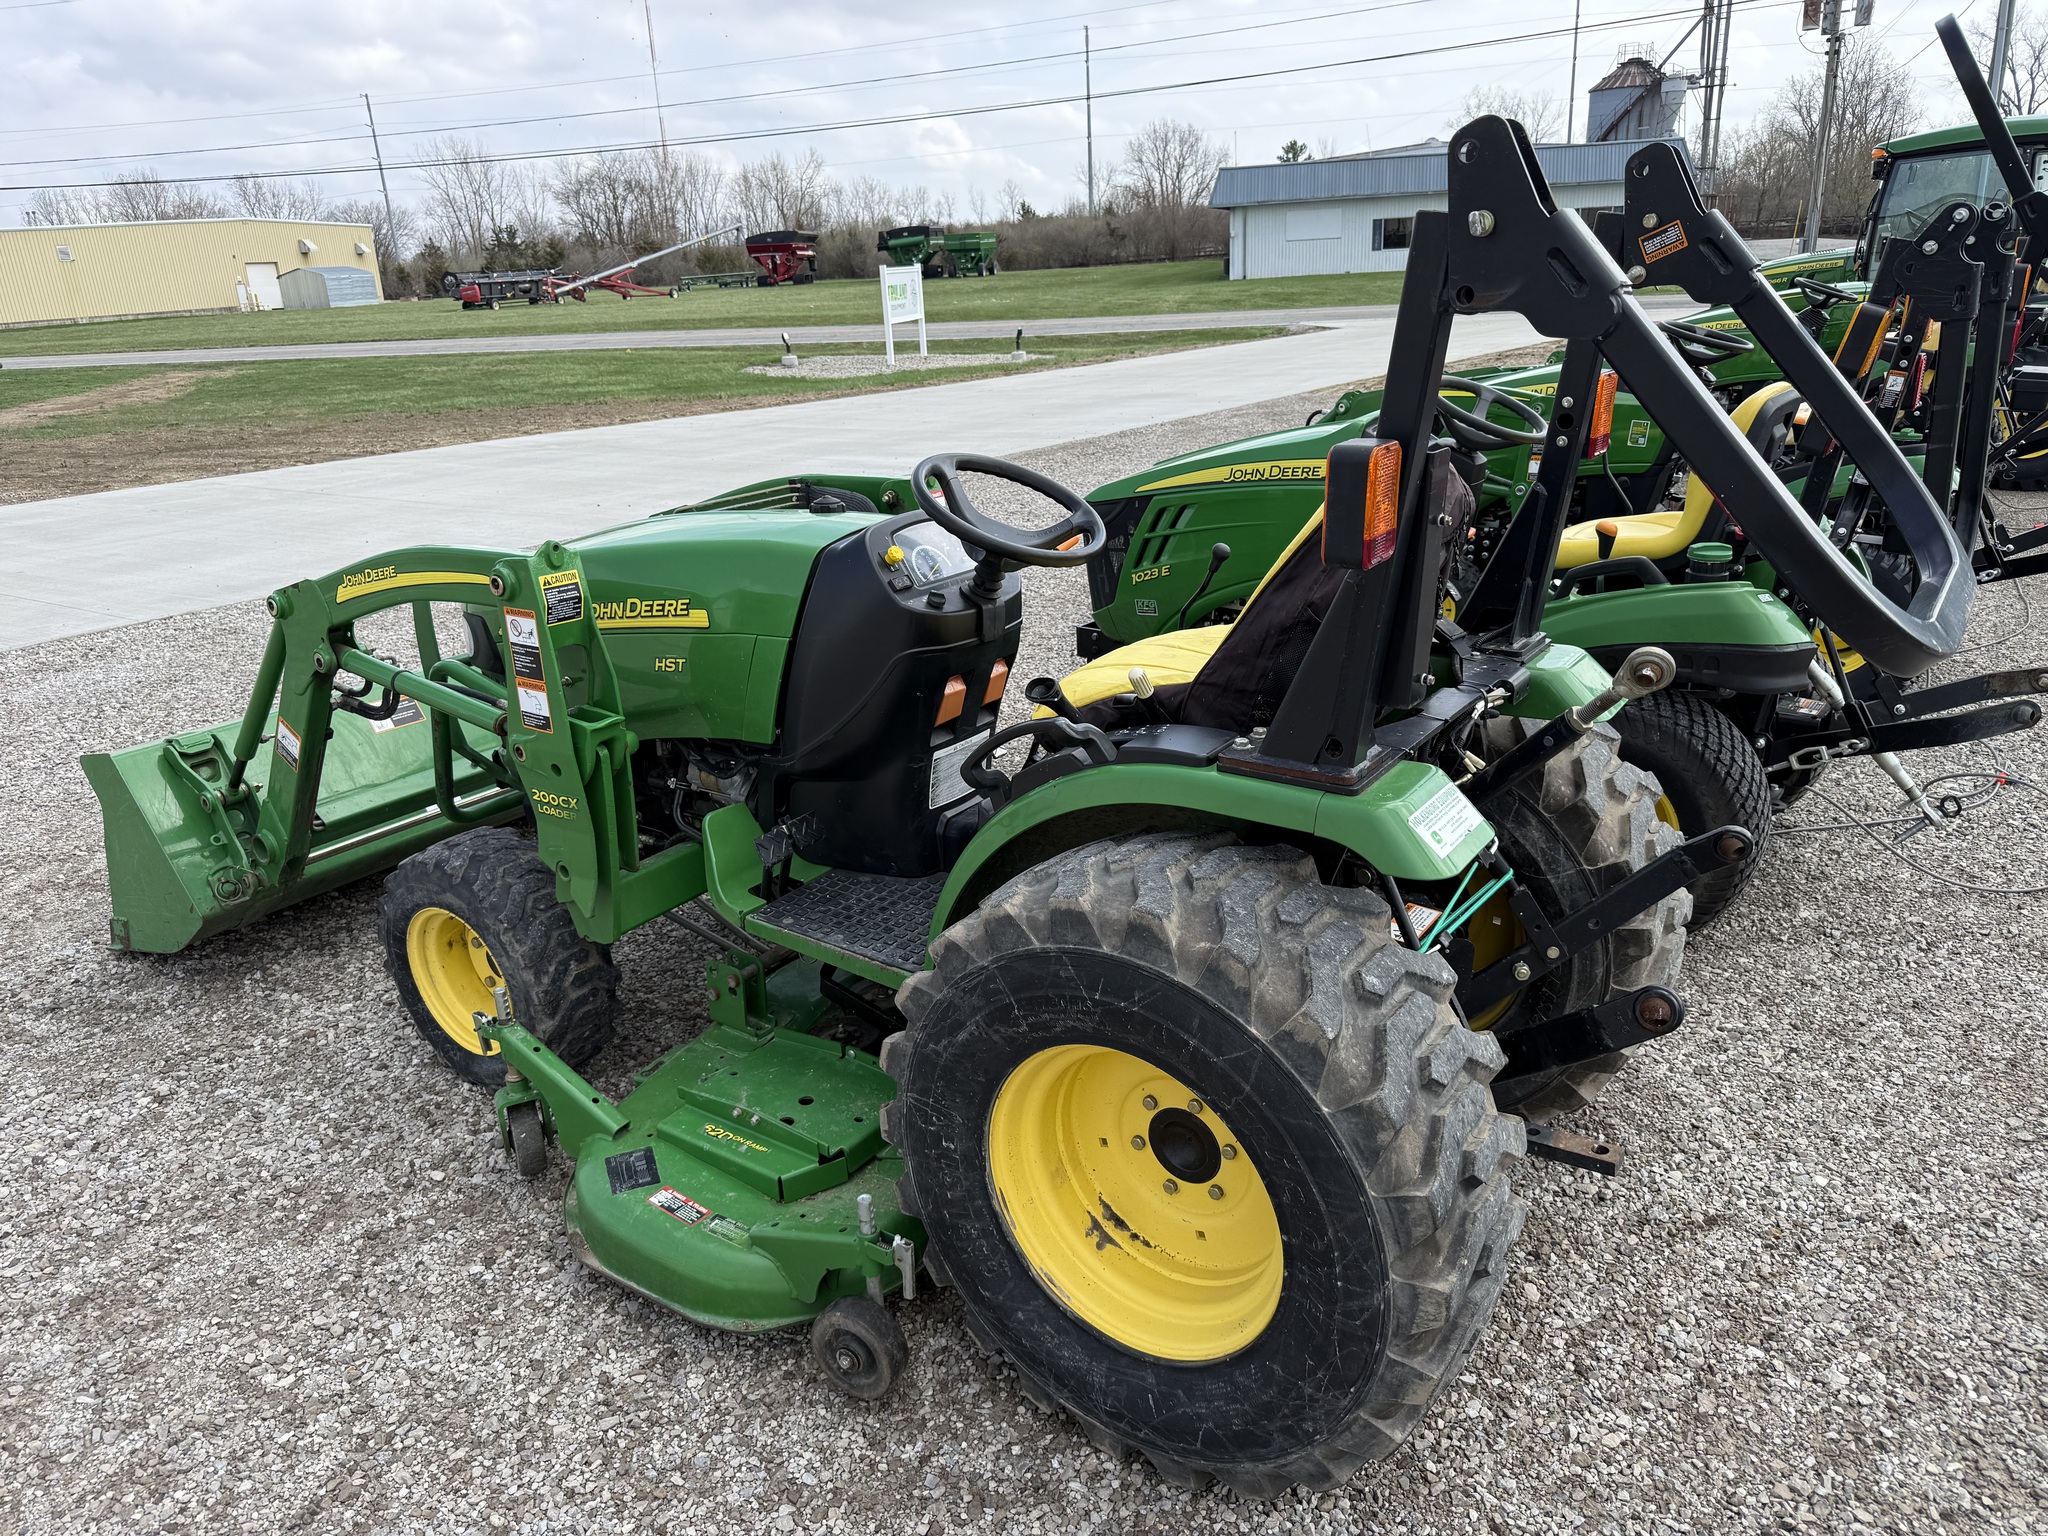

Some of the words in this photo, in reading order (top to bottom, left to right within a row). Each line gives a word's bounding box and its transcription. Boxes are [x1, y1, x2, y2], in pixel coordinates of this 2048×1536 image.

[1646, 244, 1680, 261] WARNING
[1796, 264, 1814, 272] JOHN
[1224, 467, 1266, 480] JOHN
[1269, 465, 1322, 478] DEERE
[341, 573, 365, 588] JOHN
[364, 565, 397, 583] DEERE
[550, 571, 578, 585] CAUTION
[1131, 568, 1159, 585] 1023
[1161, 565, 1171, 577] E
[509, 609, 535, 619] WARNING
[591, 602, 624, 619] OHN
[626, 597, 691, 618] DEERE
[655, 658, 686, 672] HST
[521, 680, 545, 692] WARNING
[532, 789, 578, 810] 200CX
[537, 804, 577, 820] LOADER
[671, 1189, 687, 1201] DANGER
